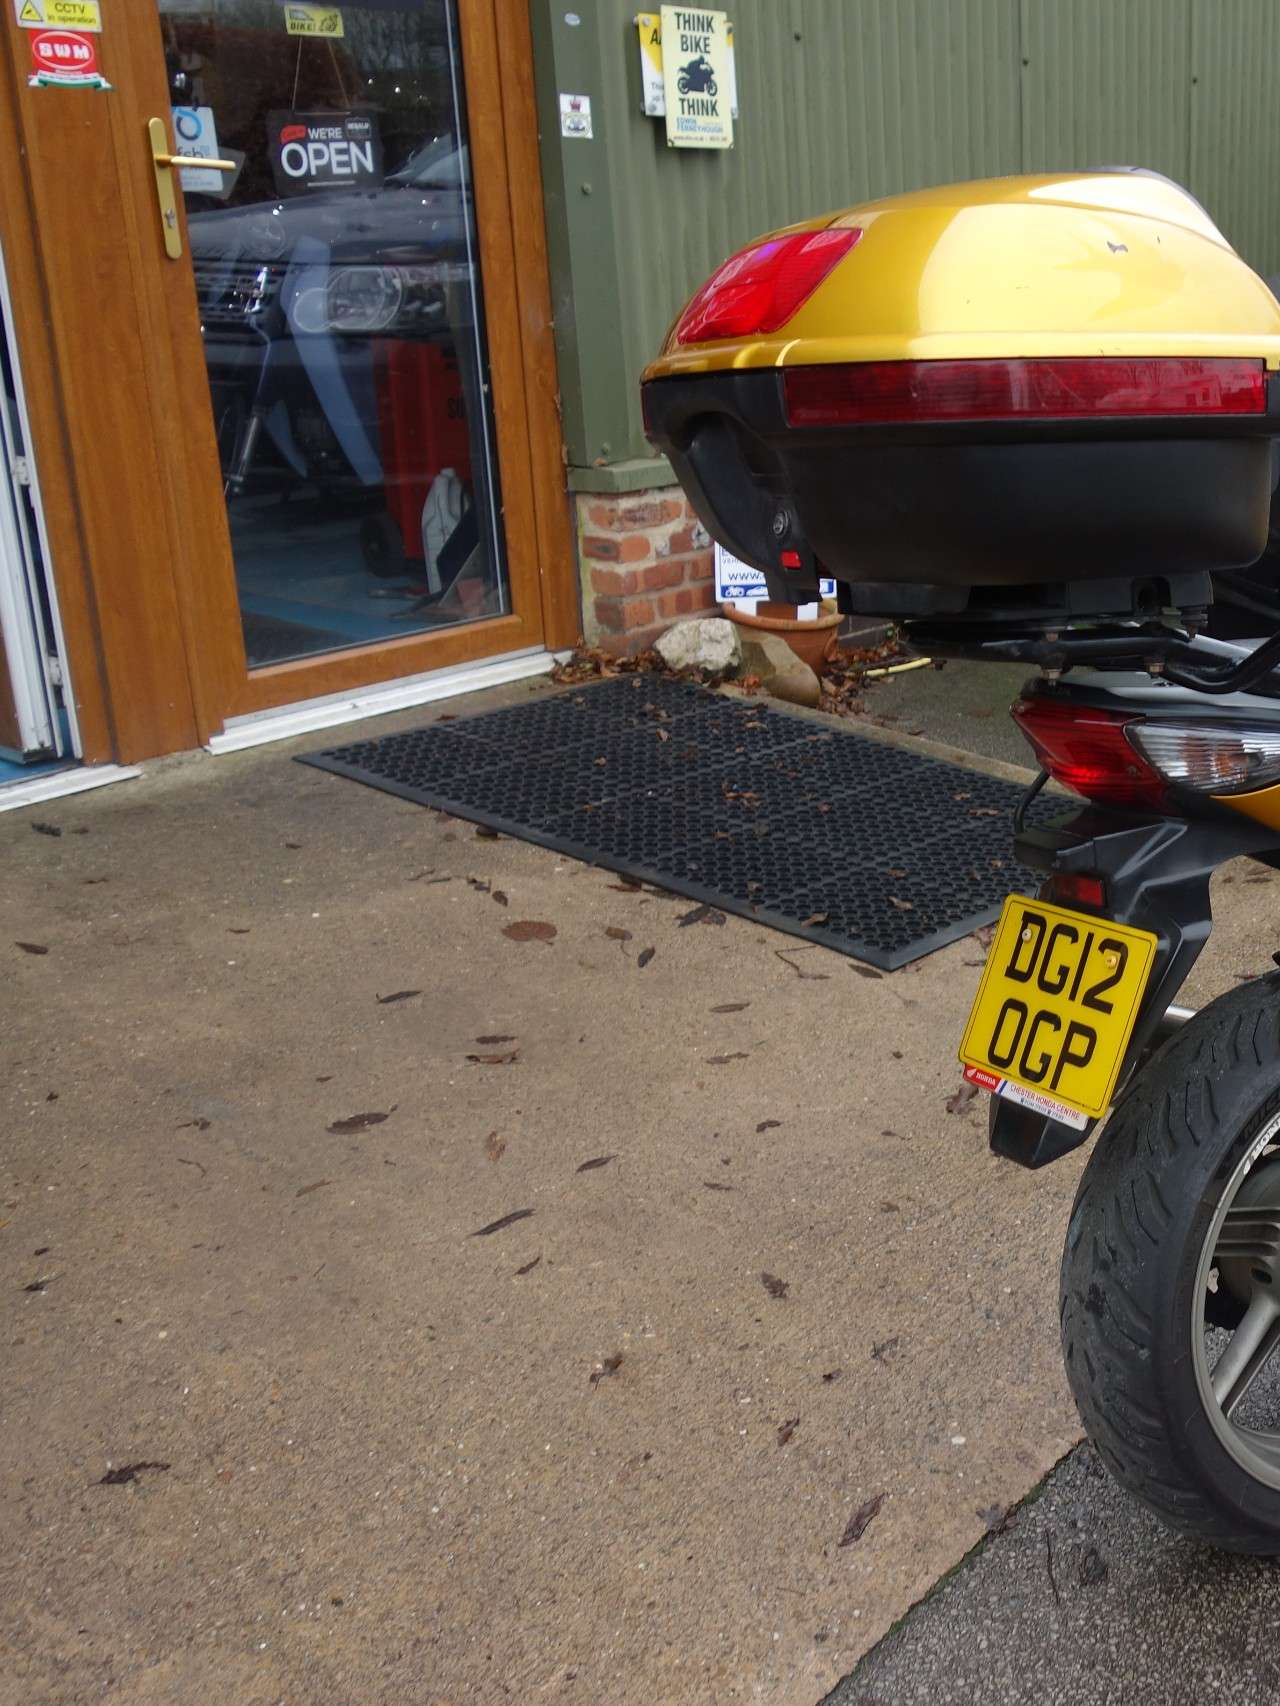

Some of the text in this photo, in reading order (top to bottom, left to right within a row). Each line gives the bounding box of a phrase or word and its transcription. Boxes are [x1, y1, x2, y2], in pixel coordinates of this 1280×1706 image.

[54, 2, 85, 14] CCTV
[57, 15, 97, 24] operation
[674, 12, 714, 33] THINK
[38, 42, 90, 60] BWM
[681, 34, 711, 54] BIKE
[679, 97, 719, 117] THINK
[308, 127, 343, 140] WE'RE
[281, 141, 374, 177] OPEN
[1004, 911, 1129, 1015] DG12
[987, 998, 1097, 1091] OGP
[976, 1071, 996, 1085] HONDA
[1010, 1084, 1036, 1101] CHESTER
[1035, 1095, 1057, 1110] HONDA
[1056, 1103, 1081, 1120] CENTRE
